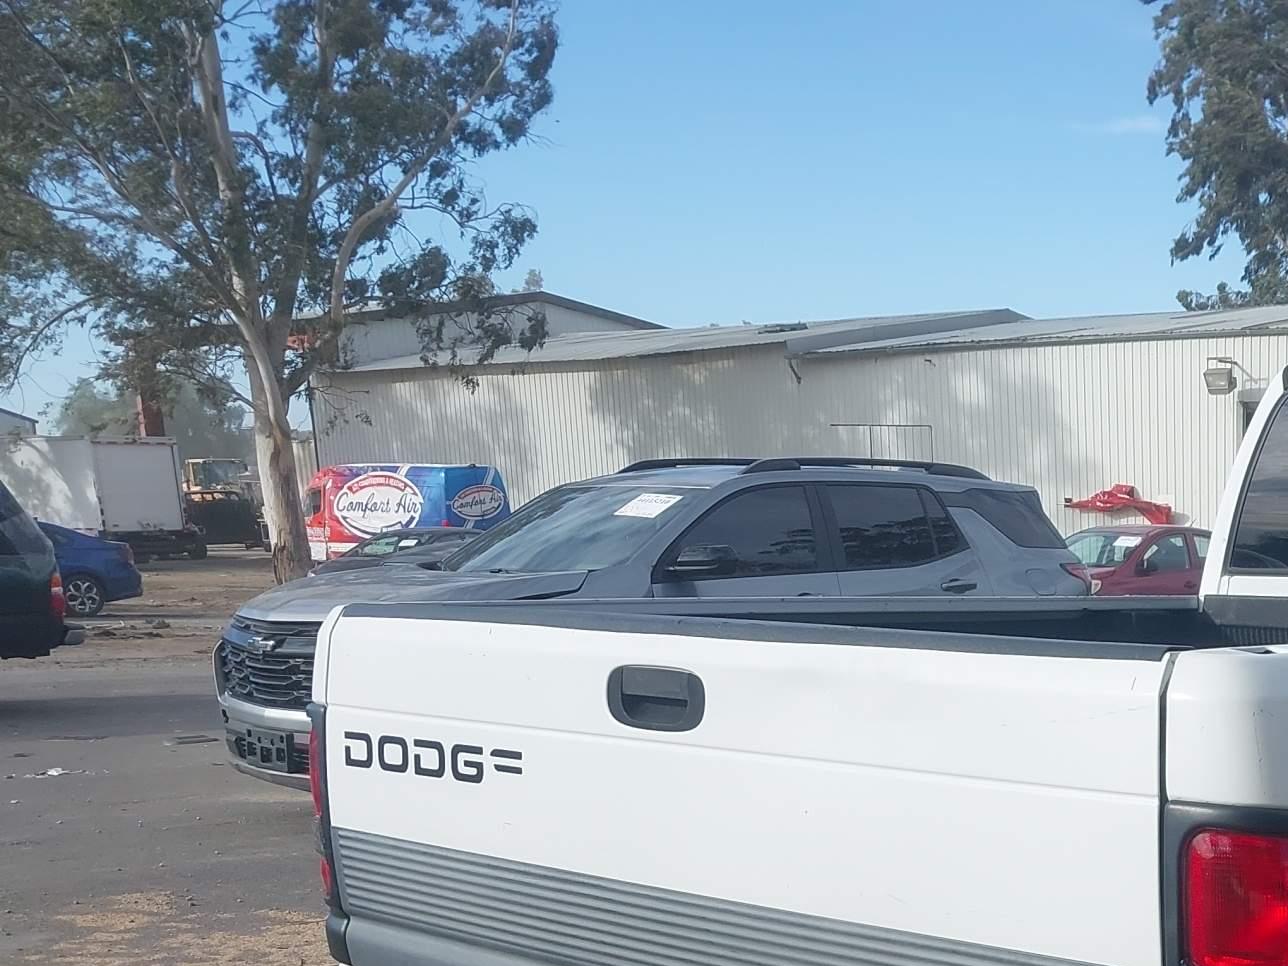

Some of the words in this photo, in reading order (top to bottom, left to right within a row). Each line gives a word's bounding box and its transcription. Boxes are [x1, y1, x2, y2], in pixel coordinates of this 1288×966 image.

[336, 491, 391, 518] Comfort
[394, 492, 419, 514] Air
[344, 730, 523, 784] DODGE
